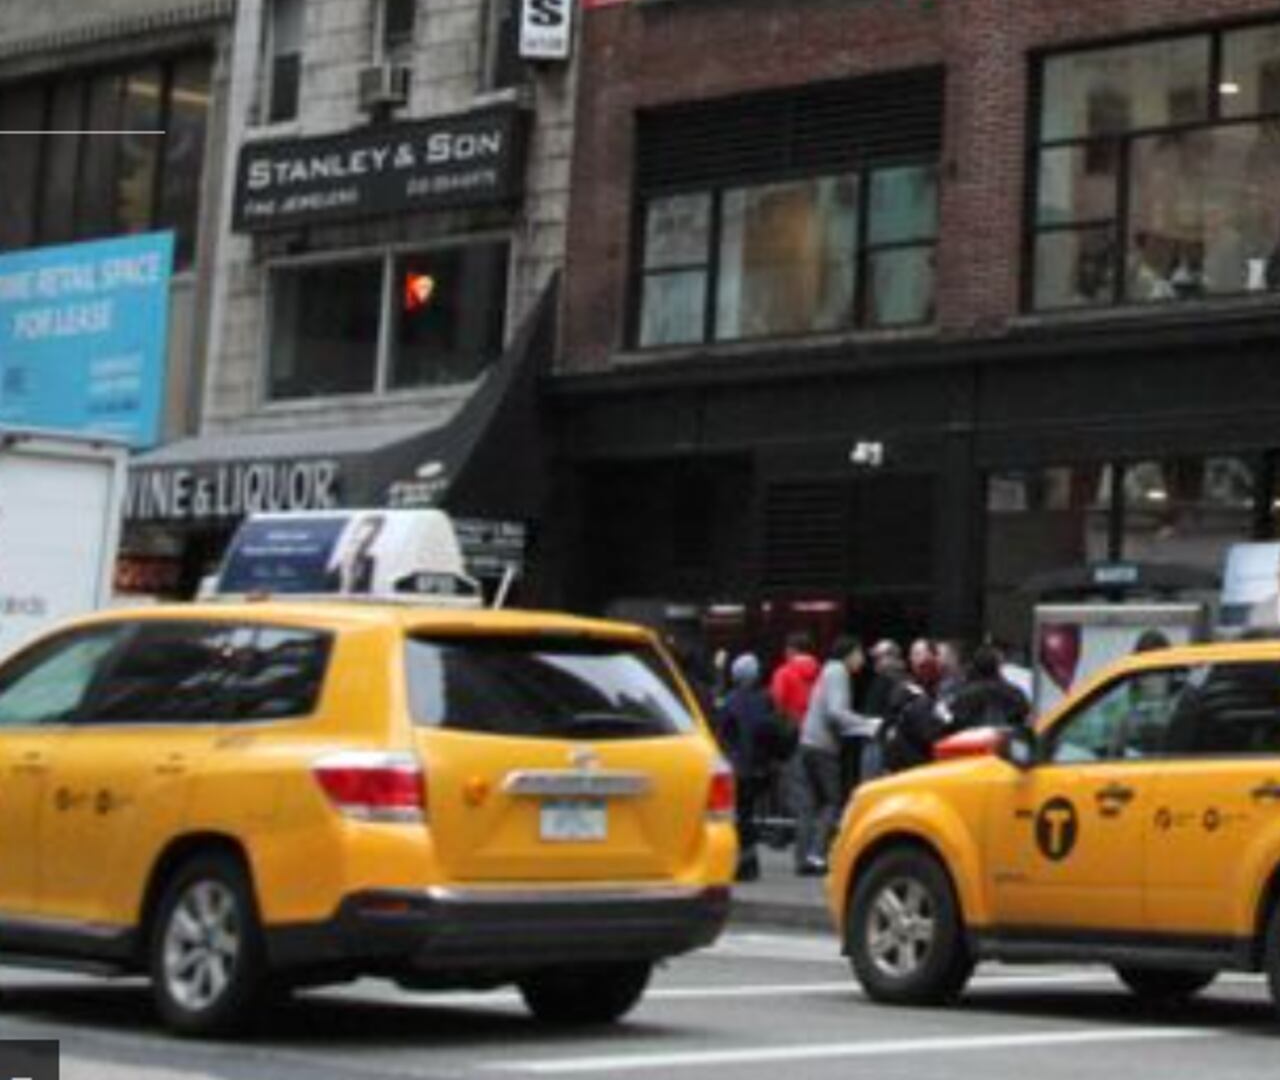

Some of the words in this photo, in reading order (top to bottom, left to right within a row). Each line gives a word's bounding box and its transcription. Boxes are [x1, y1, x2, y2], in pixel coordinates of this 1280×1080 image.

[247, 148, 390, 191] STANLEY
[393, 142, 415, 168] &
[426, 131, 499, 163] SON
[216, 461, 340, 515] LIQUOR
